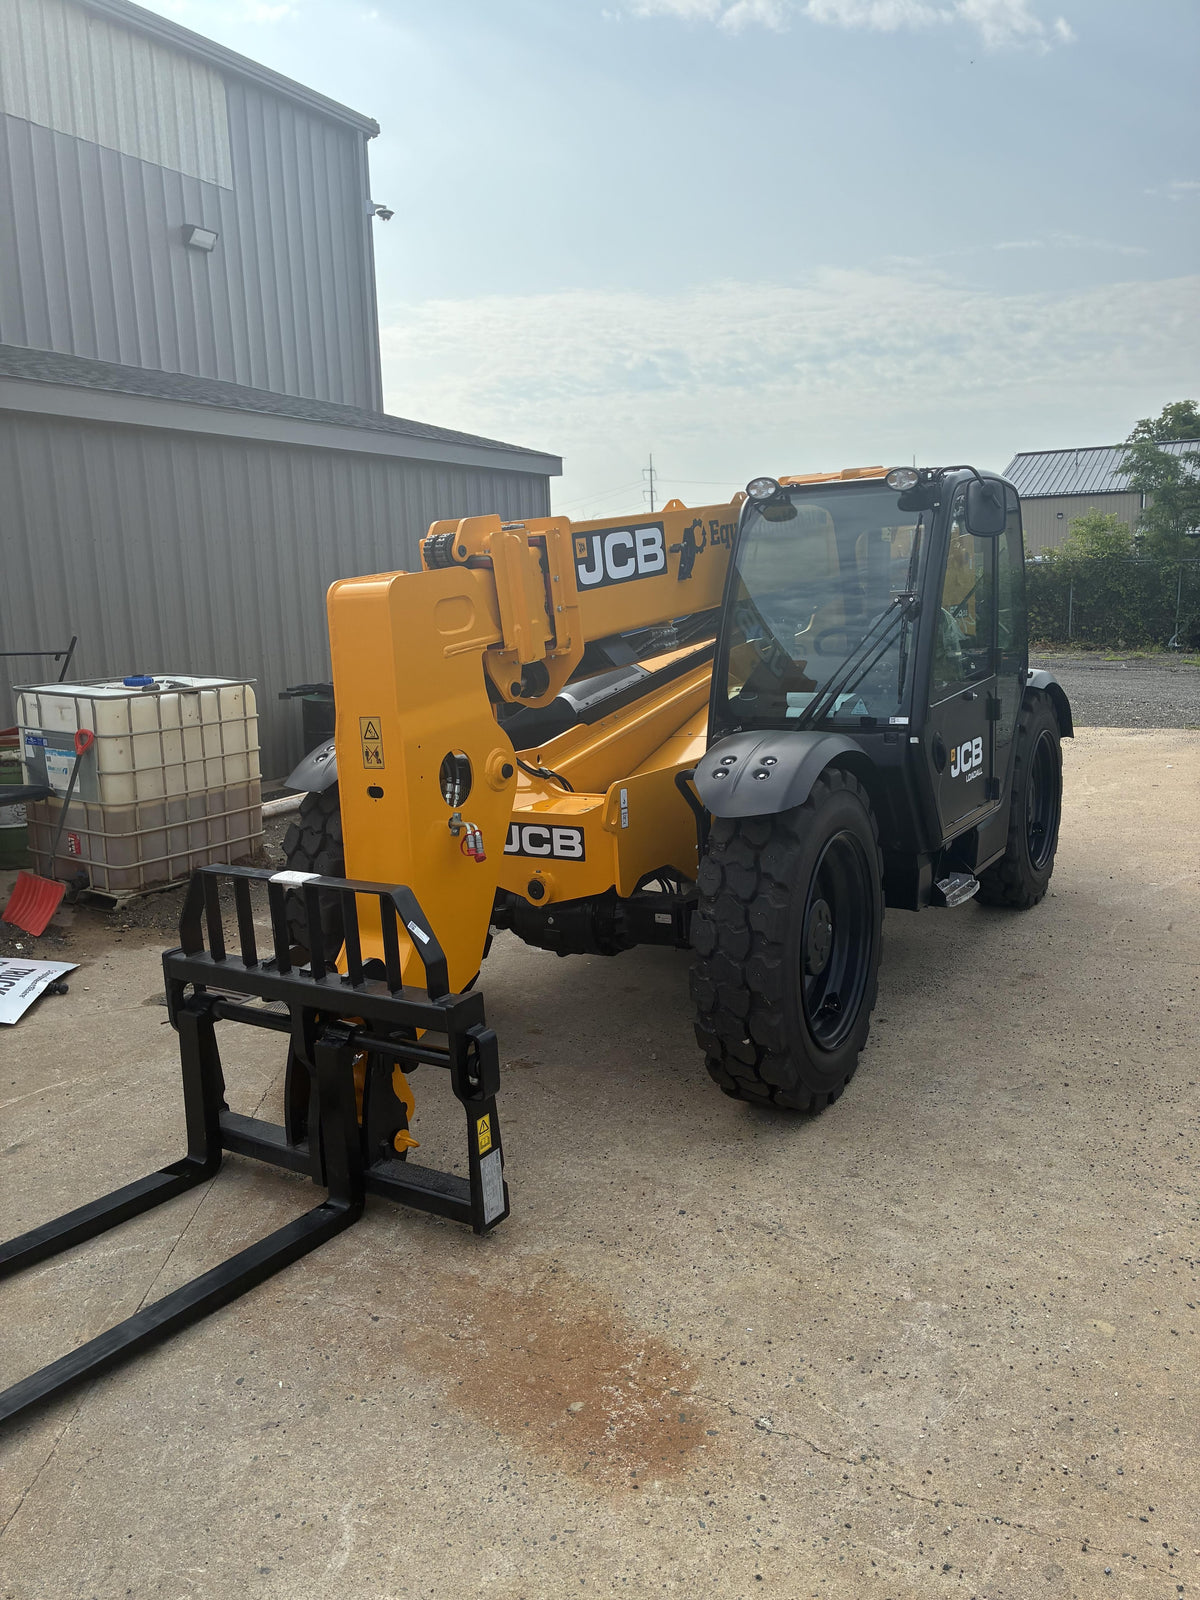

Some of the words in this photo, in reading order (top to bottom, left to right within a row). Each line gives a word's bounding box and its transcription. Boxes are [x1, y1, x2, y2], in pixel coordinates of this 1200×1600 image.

[578, 527, 665, 585] JCB
[950, 736, 983, 778] JCB
[504, 825, 583, 858] JCB
